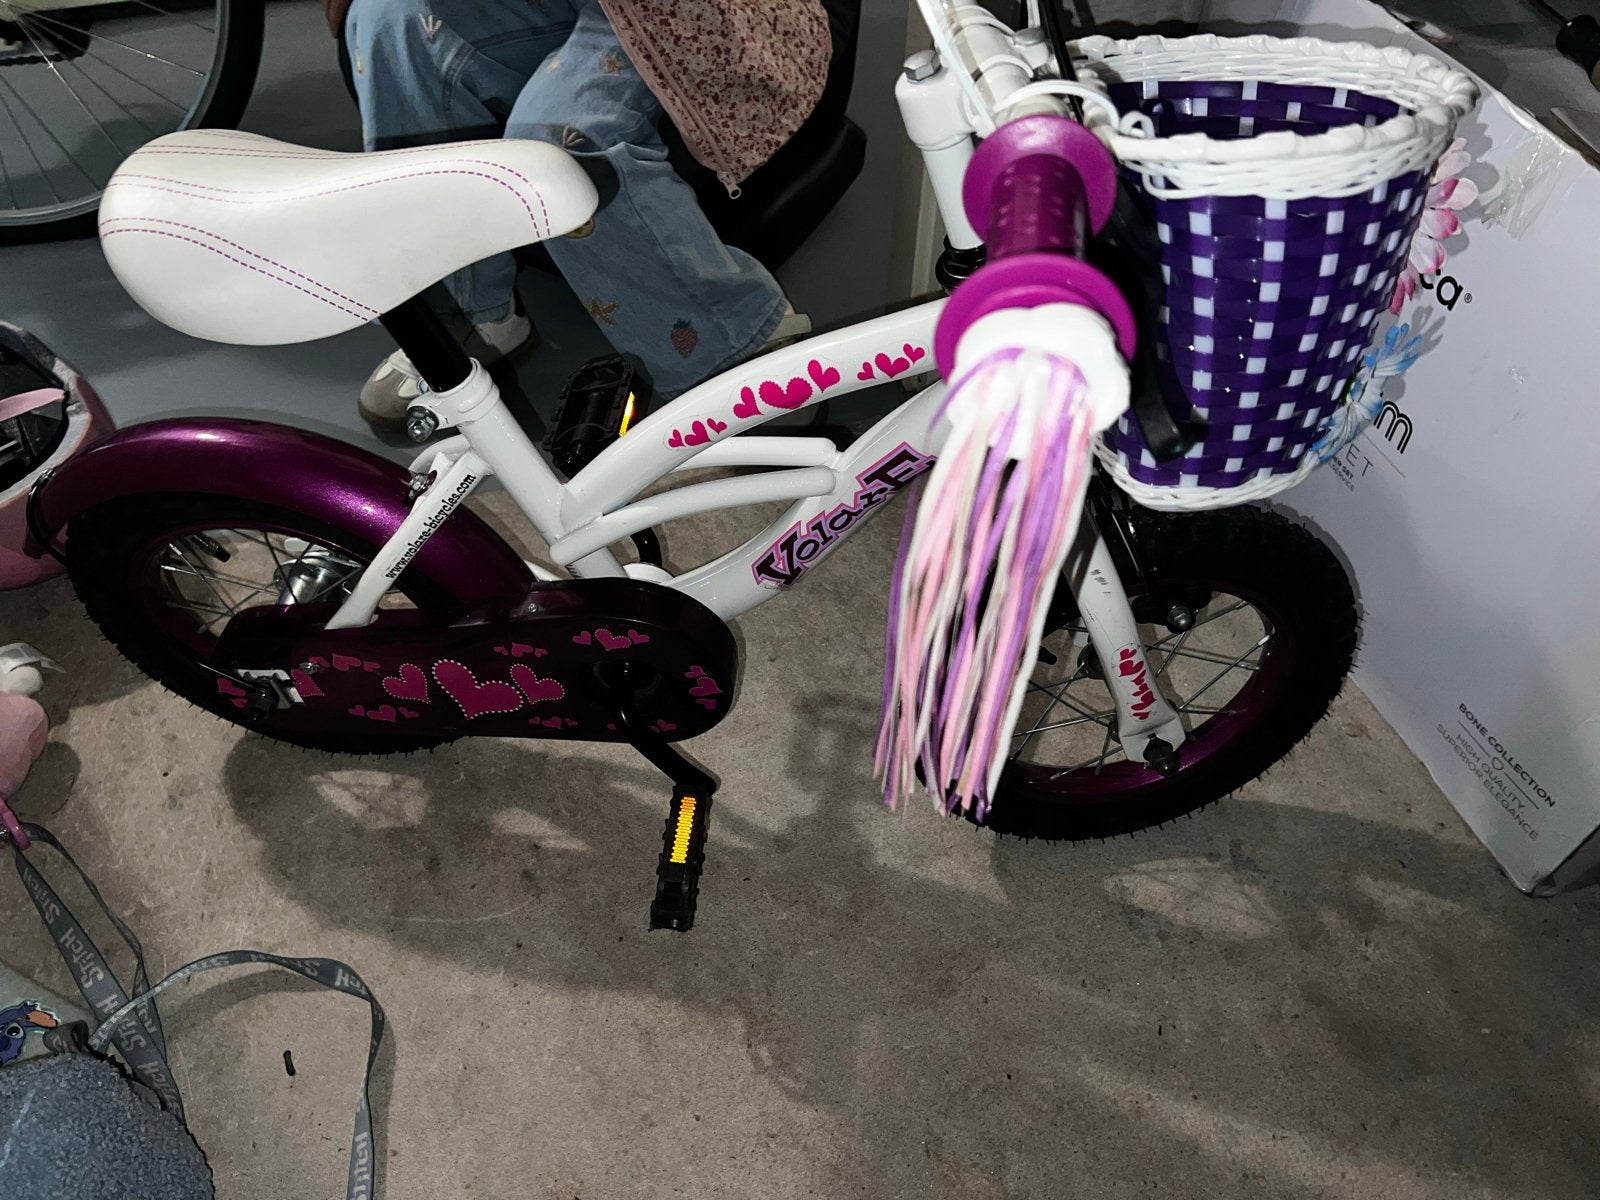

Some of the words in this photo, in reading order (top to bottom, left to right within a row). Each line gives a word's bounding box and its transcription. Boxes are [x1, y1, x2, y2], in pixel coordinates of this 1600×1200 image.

[385, 473, 477, 580] www.volare-bicycles.com
[1436, 723, 1485, 781] SUPERIOR
[1482, 778, 1539, 842] ELEGANCE
[1456, 733, 1481, 764] HIGH
[1458, 702, 1489, 737] BONE
[1487, 735, 1556, 808] COLLECTION
